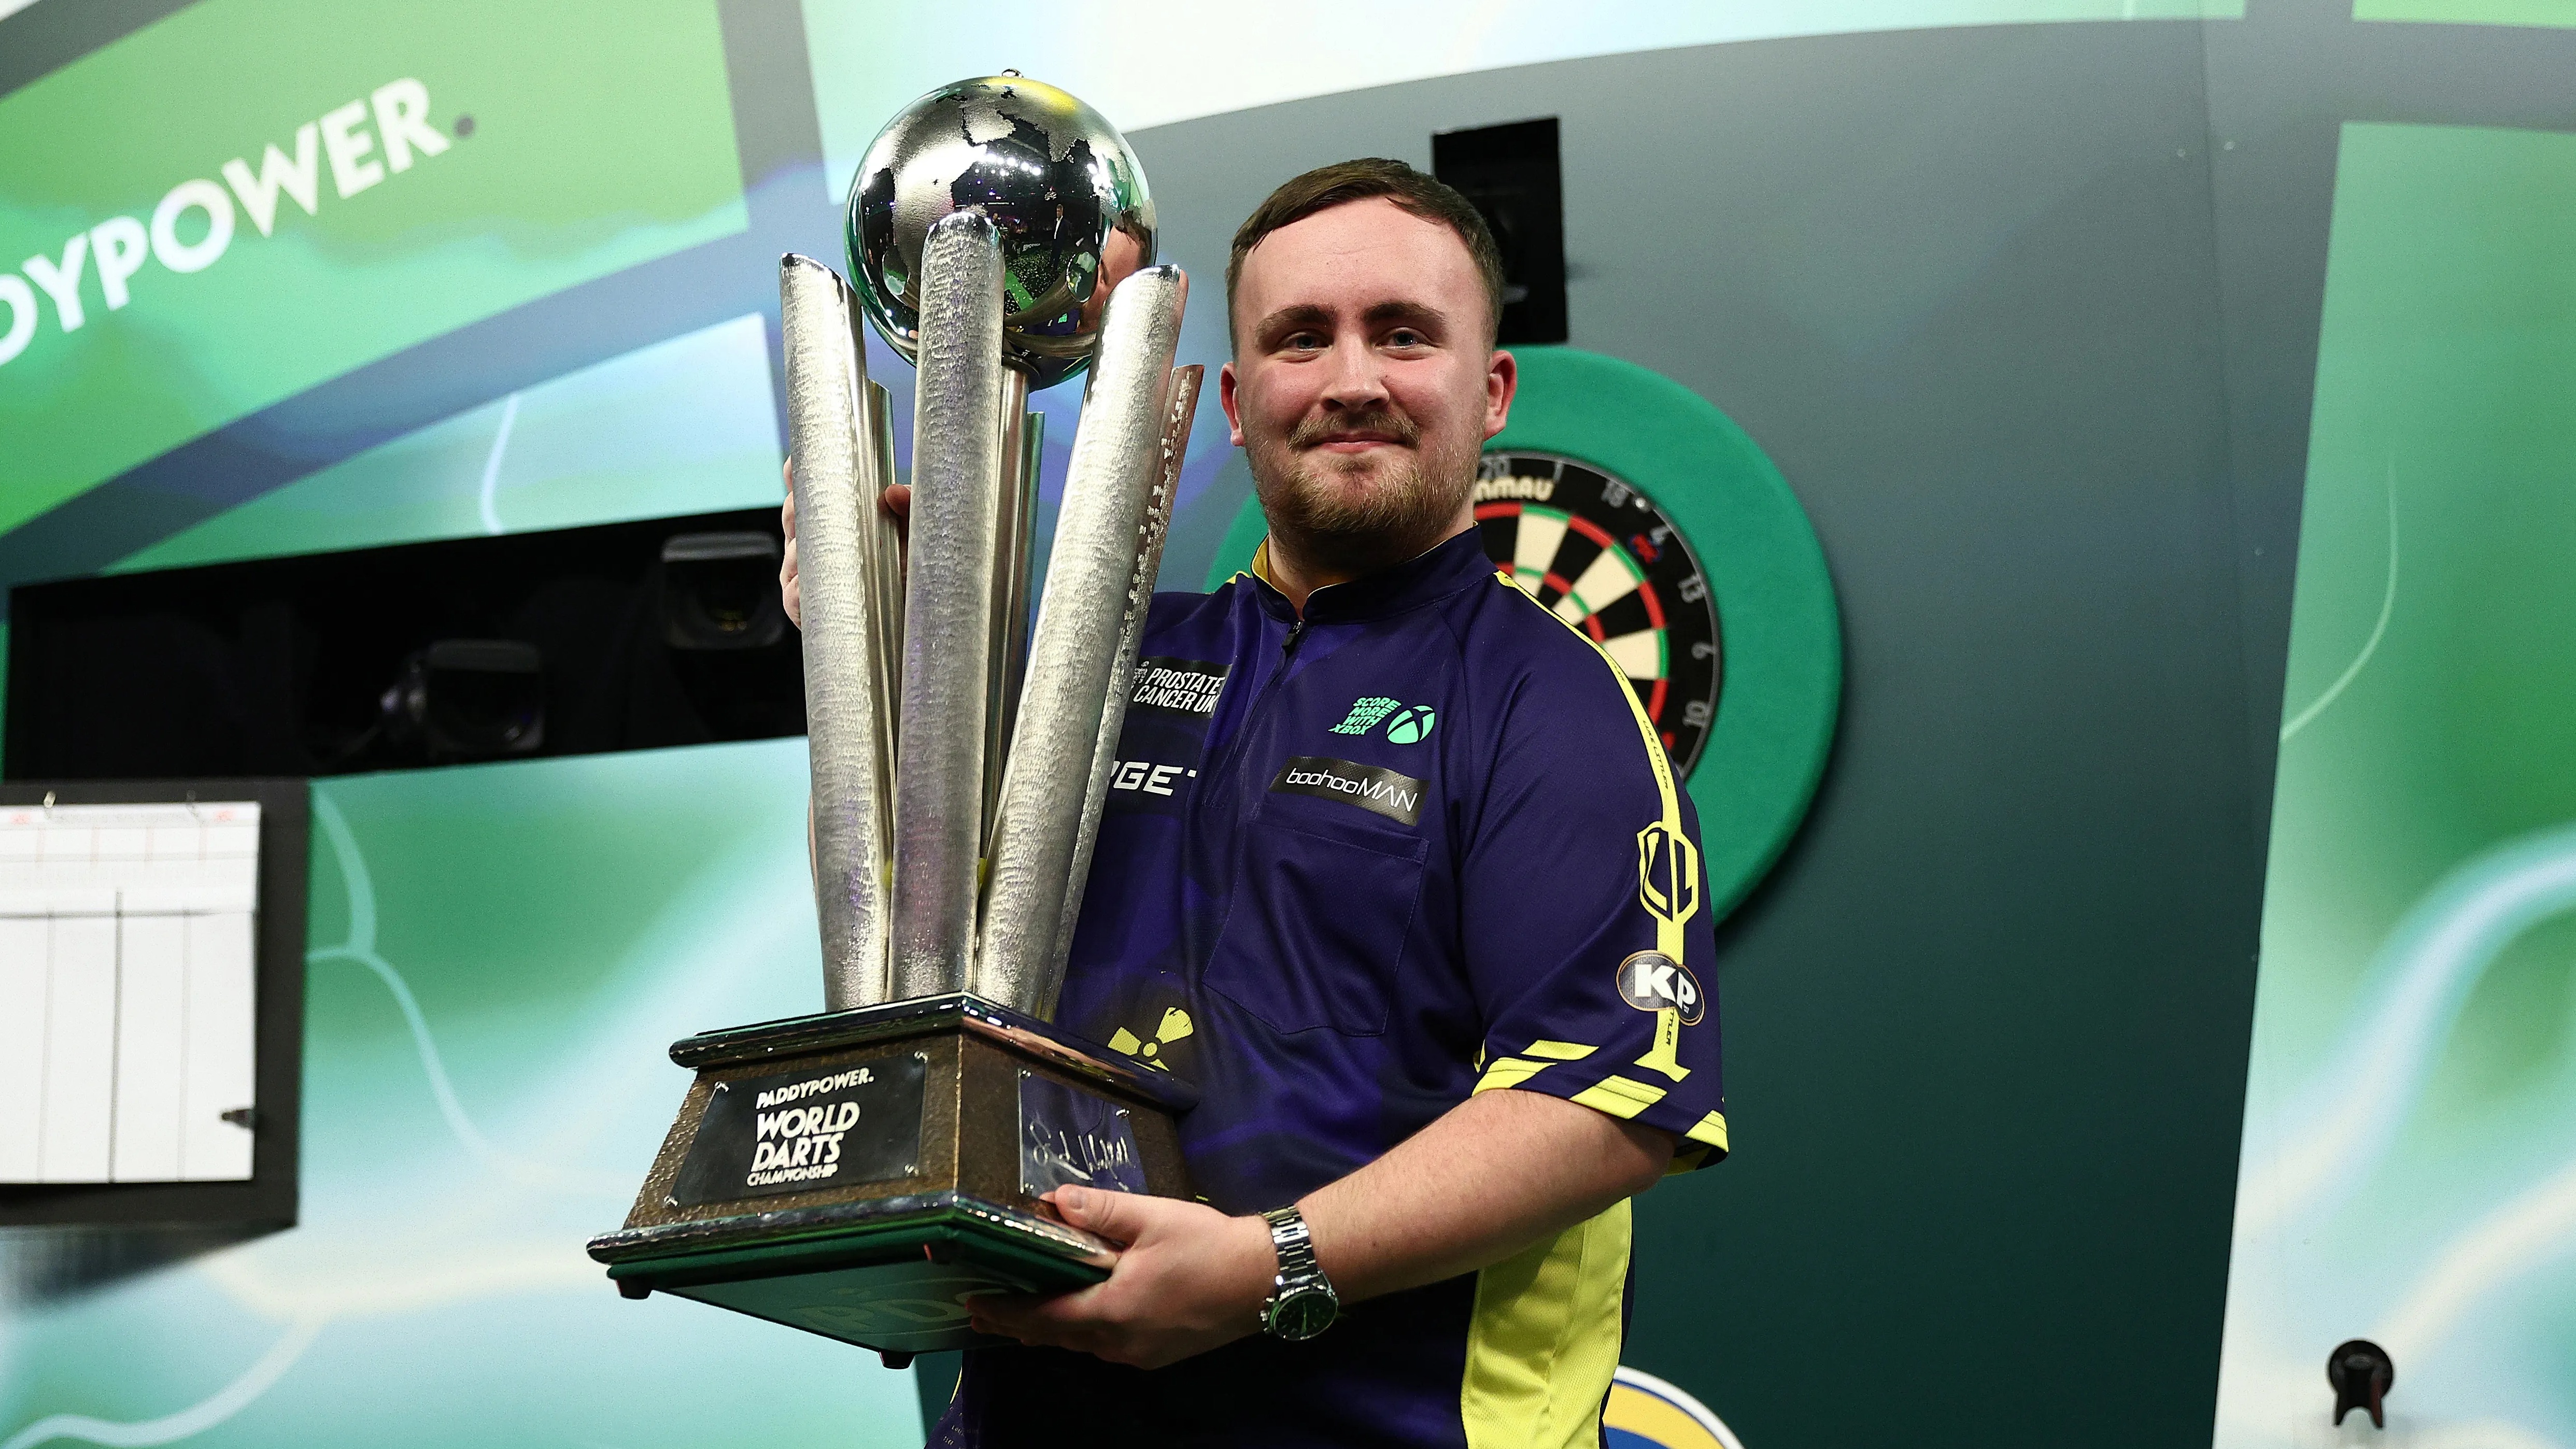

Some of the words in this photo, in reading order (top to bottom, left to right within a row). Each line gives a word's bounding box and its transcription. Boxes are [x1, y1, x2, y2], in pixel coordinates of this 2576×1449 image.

[1145, 667, 1226, 695] PROSTATE
[1133, 685, 1198, 711] CANCER
[1193, 694, 1221, 713] UK
[1348, 706, 1392, 719] MORE
[1353, 697, 1402, 711] SCORE
[1327, 723, 1372, 735] XBOX
[1342, 716, 1382, 726] WITH
[1286, 768, 1418, 812] boohooMAN
[1635, 963, 1696, 1010] KP
[756, 1067, 875, 1110] PADDYPOWER.
[757, 1101, 861, 1142] WORLD
[751, 1132, 845, 1173] DARTS
[746, 1163, 839, 1187] CHAMPIONSHIP
